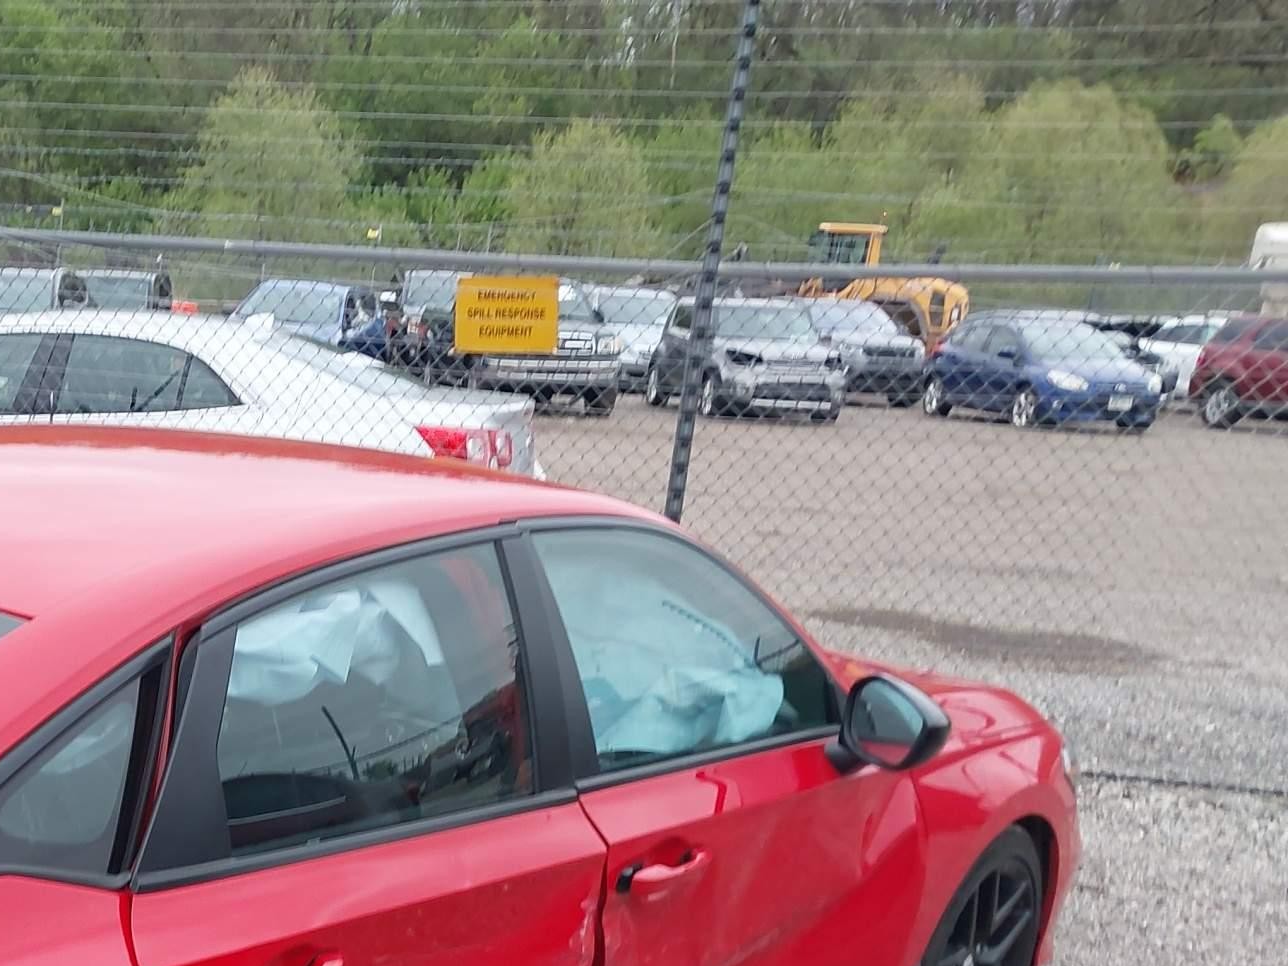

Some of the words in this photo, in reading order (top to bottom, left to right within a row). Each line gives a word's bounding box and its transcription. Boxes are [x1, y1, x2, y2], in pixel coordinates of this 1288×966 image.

[478, 289, 536, 302] EMERGENCY
[467, 306, 492, 319] SPILL
[495, 306, 545, 319] RESPONSE
[479, 325, 533, 338] EQUIPMENT
